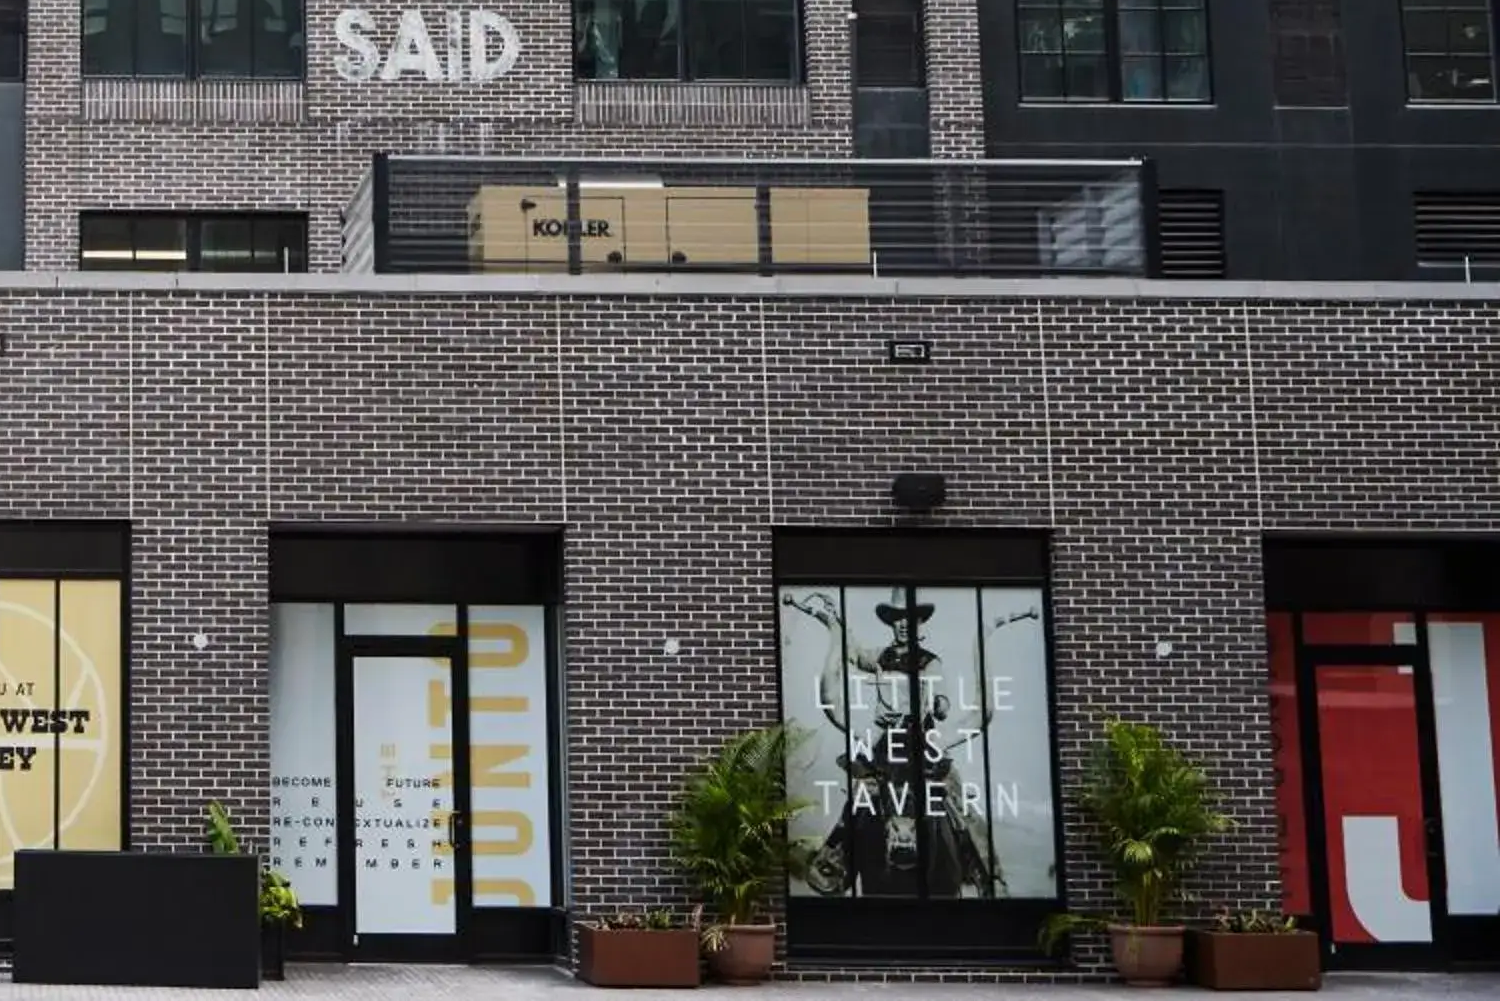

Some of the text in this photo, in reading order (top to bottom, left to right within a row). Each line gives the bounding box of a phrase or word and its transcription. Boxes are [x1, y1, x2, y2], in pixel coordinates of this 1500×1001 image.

[334, 8, 521, 83] SAID
[533, 218, 610, 237] KOLER
[15, 682, 36, 696] AT
[814, 676, 1015, 711] LITTLE
[0, 709, 91, 734] WEST
[849, 728, 982, 763] WEST
[272, 776, 441, 788] BECOME FUTURE
[427, 622, 536, 908] JUNTO
[813, 780, 1020, 817] TAVERN
